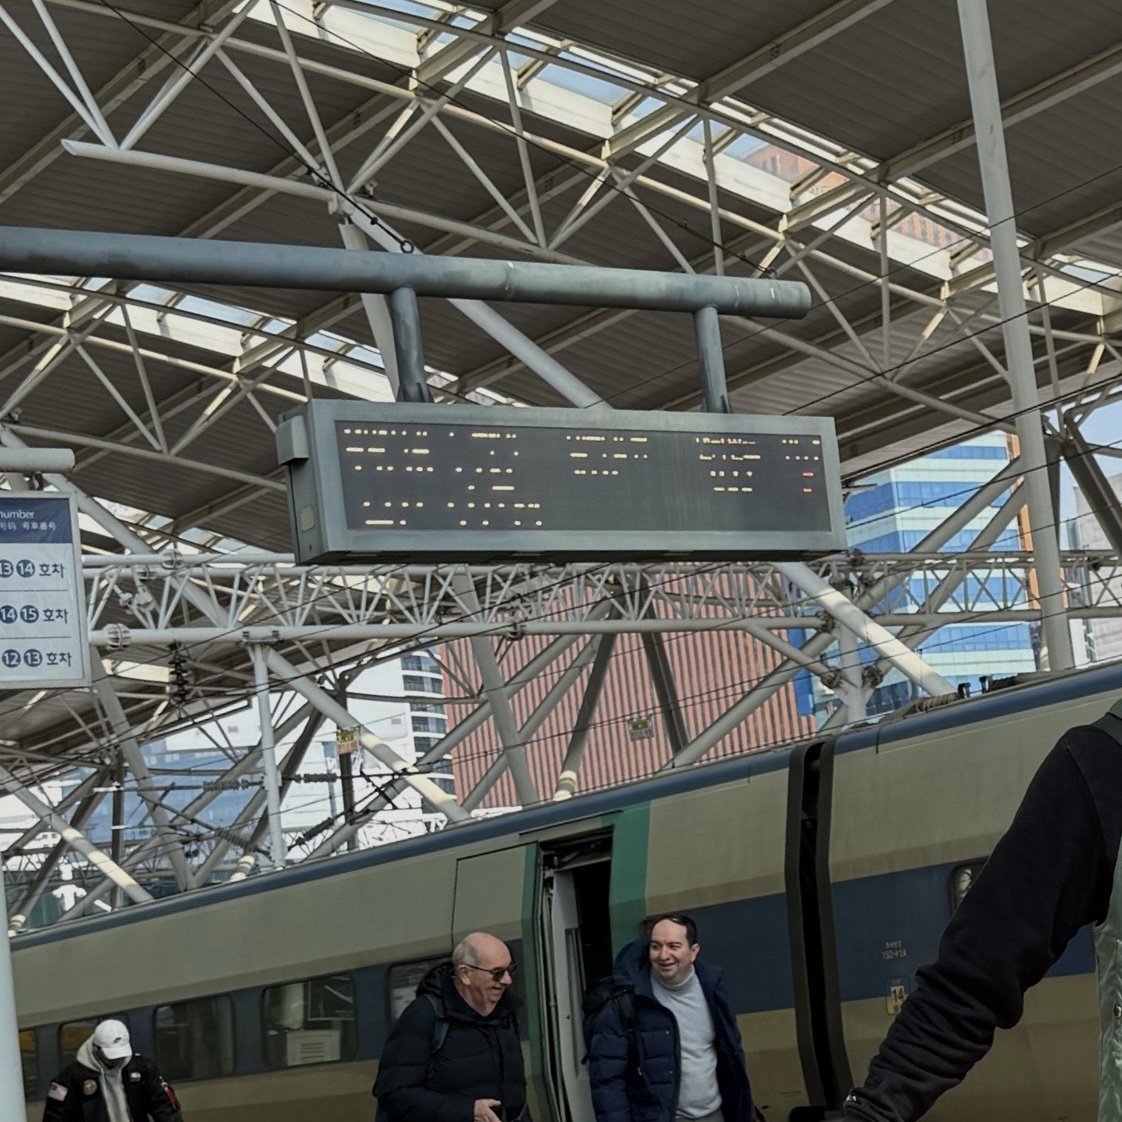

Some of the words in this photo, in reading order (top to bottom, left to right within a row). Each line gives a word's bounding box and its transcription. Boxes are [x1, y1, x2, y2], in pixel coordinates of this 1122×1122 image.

[17, 561, 35, 576] 14
[0, 606, 17, 622] 14
[21, 606, 38, 622] 15
[3, 650, 20, 666] 12
[25, 650, 42, 666] 13
[892, 987, 904, 1003] 14
